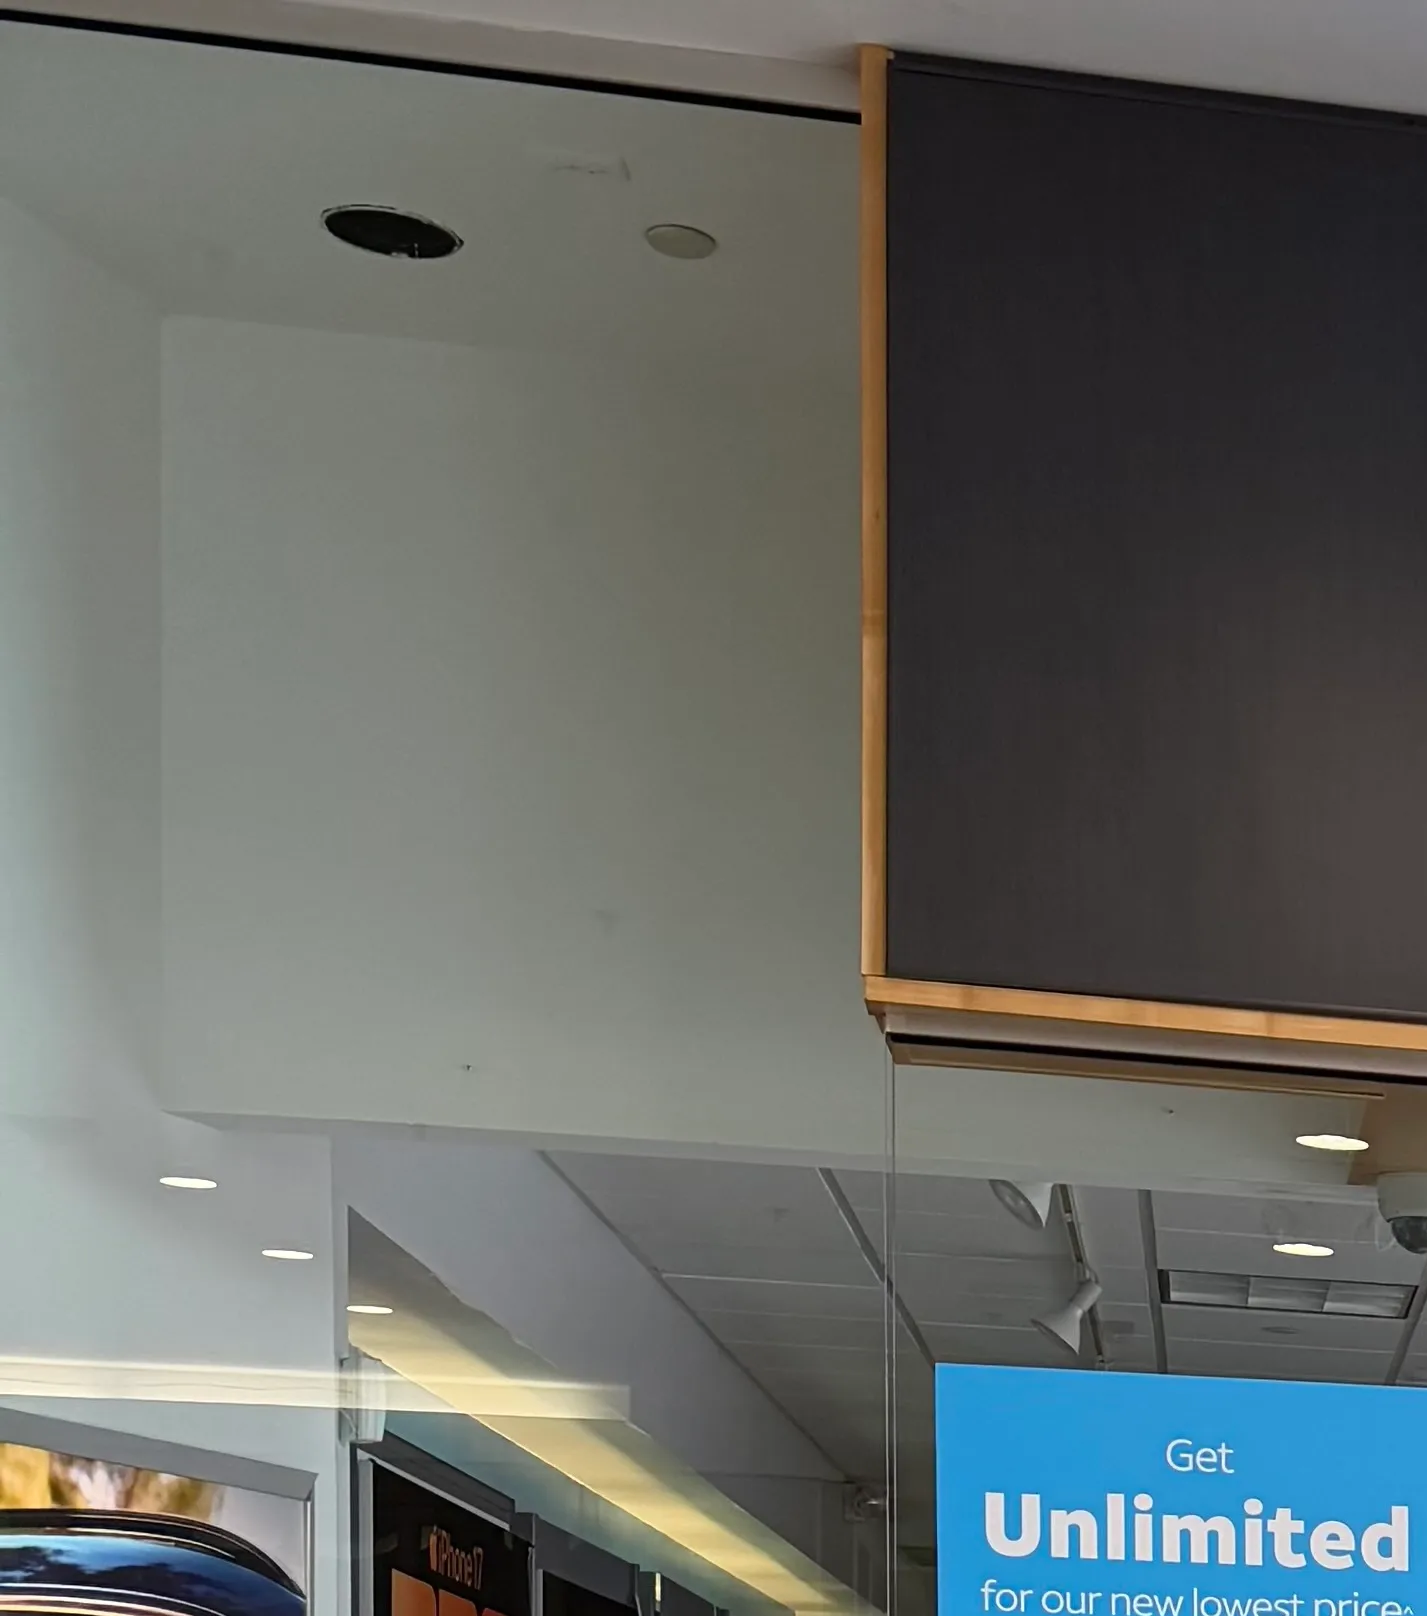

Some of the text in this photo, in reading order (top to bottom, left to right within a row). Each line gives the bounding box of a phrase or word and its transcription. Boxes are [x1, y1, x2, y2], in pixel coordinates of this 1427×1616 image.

[1166, 1438, 1235, 1474] Get
[984, 1491, 1410, 1572] Unlimited
[981, 1579, 1033, 1613] for
[1042, 1590, 1102, 1616] our
